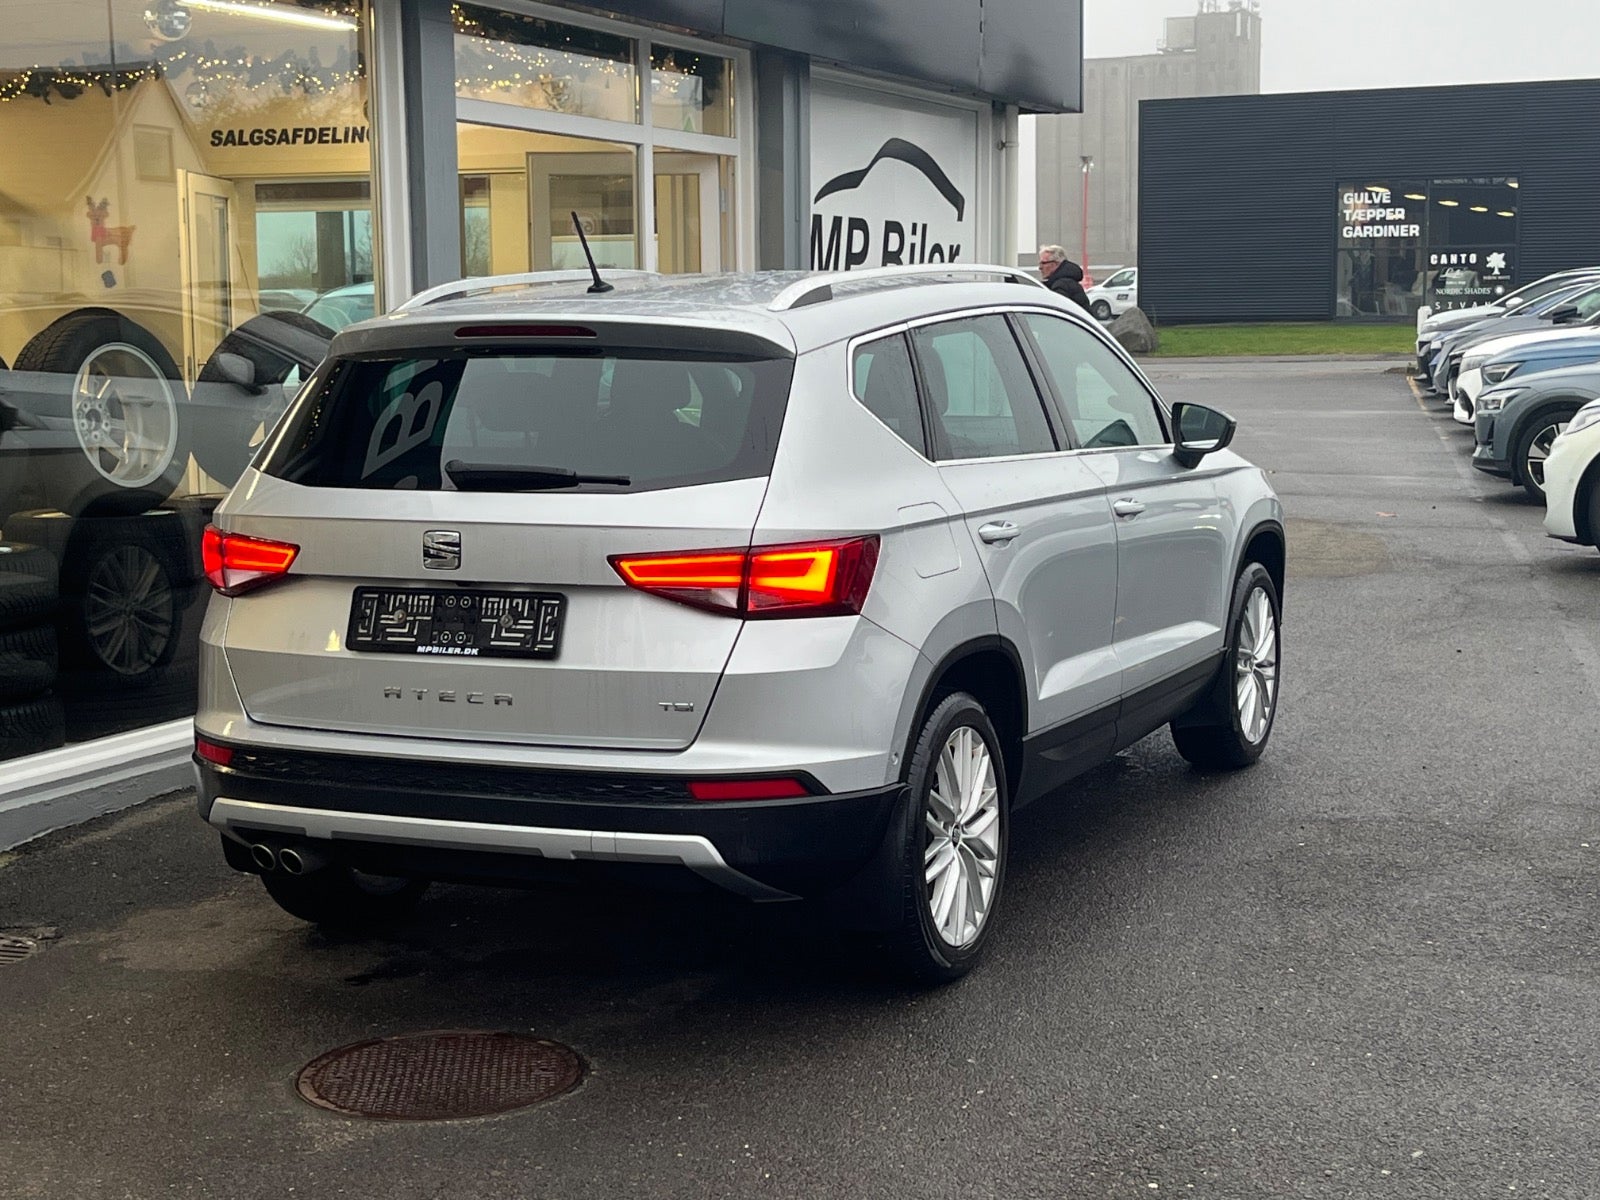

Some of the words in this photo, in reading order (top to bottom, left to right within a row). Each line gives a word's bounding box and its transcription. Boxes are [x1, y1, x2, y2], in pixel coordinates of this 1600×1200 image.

[210, 126, 369, 147] SALGSAFDELIN
[1343, 191, 1391, 204] GULVE
[1343, 207, 1405, 221] TÆPPER
[1342, 224, 1420, 238] GARDINER
[811, 214, 870, 271] MP
[1430, 253, 1477, 265] CANTO
[1435, 287, 1463, 295] NORDIC
[1464, 287, 1492, 295] SHADES
[416, 645, 479, 655] MPBILER.DK
[383, 686, 513, 706] ATECA
